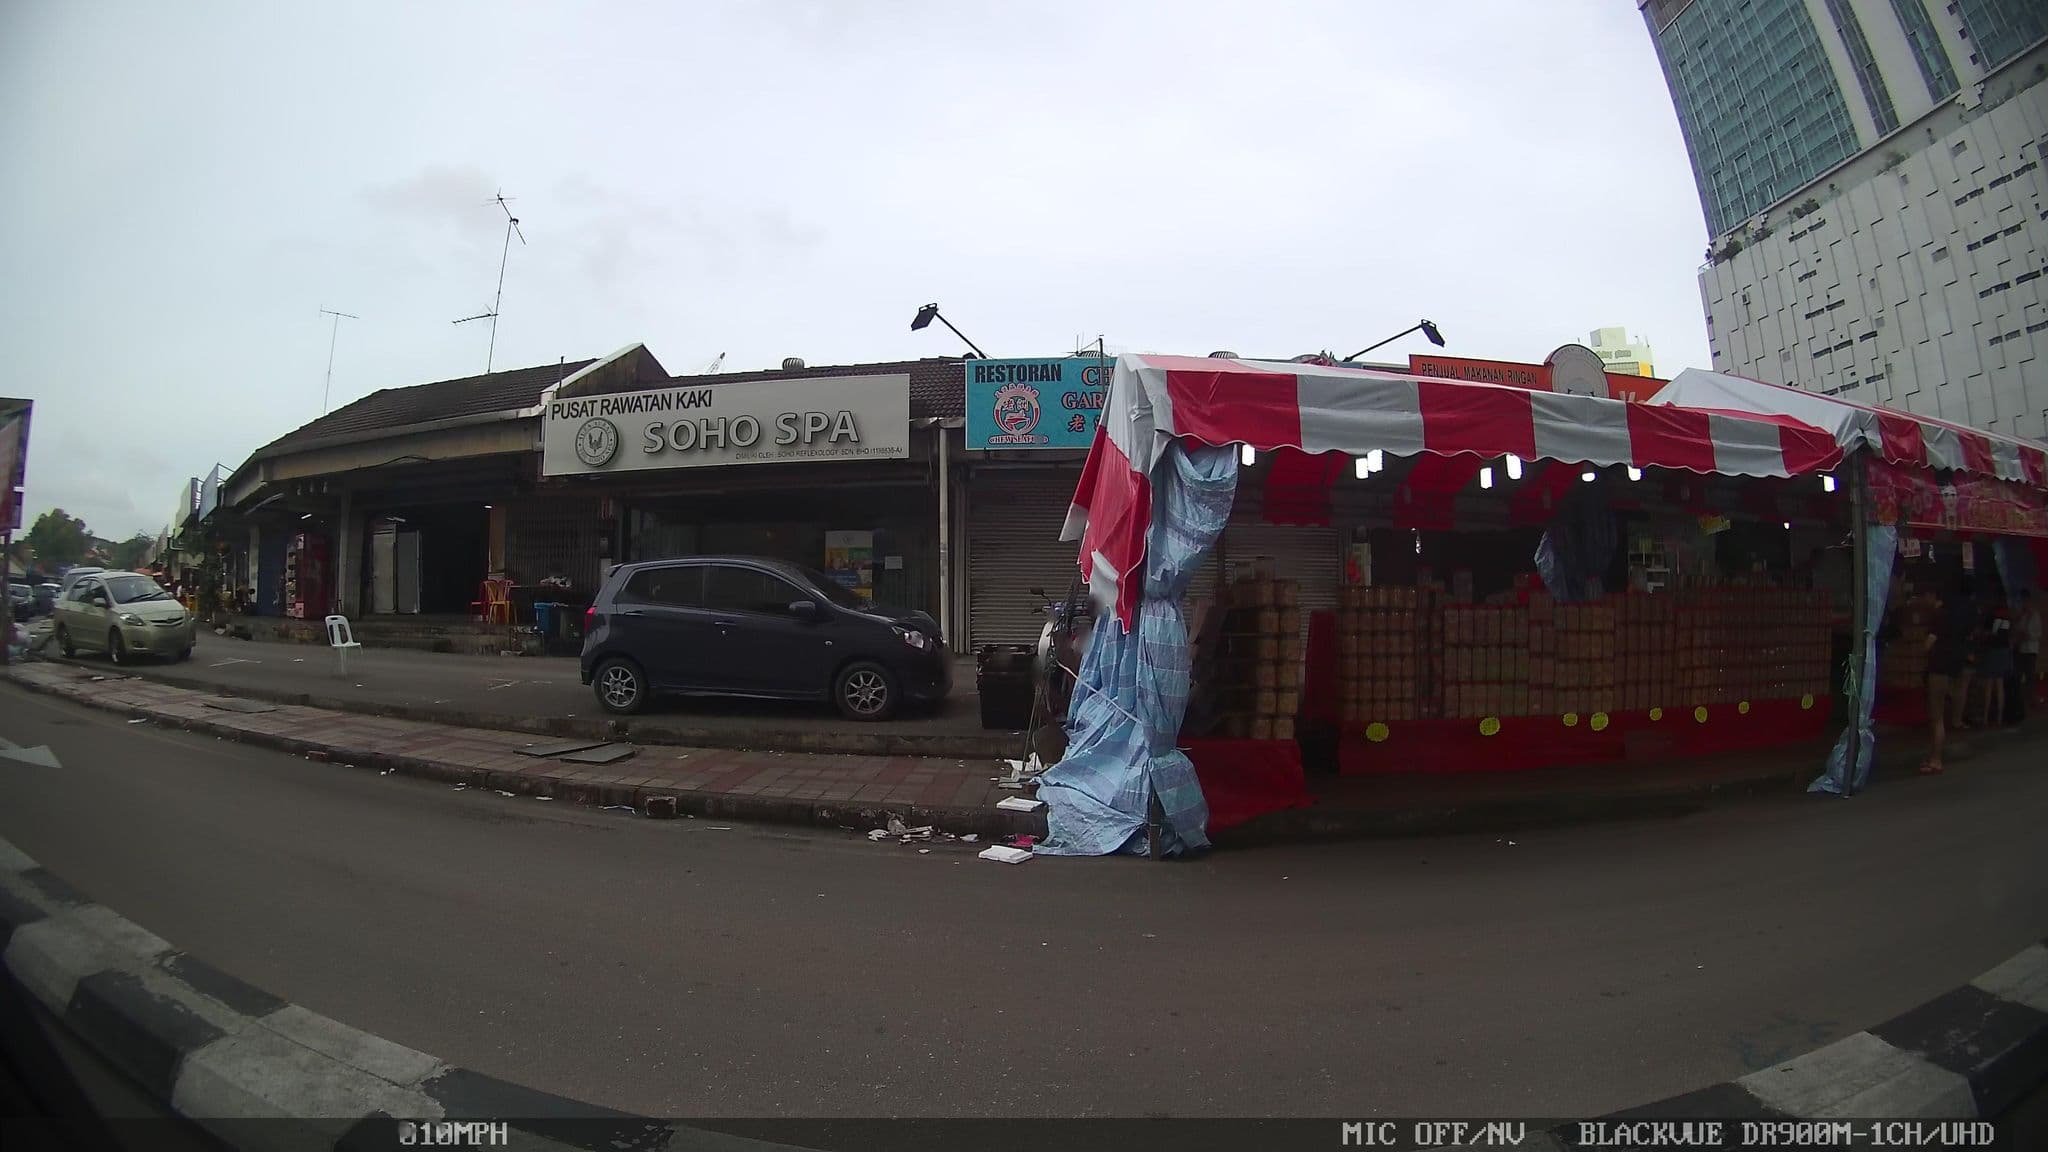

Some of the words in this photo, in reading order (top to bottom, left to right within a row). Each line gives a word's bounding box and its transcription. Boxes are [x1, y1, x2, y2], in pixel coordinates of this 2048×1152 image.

[976, 364, 1062, 383] RESTORAN
[1421, 363, 1460, 378] PENJUAL
[1464, 366, 1504, 382] MAKANAN
[1507, 369, 1537, 385] RINGAN
[551, 400, 598, 420] PUSAT
[600, 392, 672, 416] RAWATAN
[676, 389, 712, 410] KAKI
[643, 414, 761, 453] SOHO
[775, 411, 860, 445] SPA
[1067, 413, 1099, 433] 老
